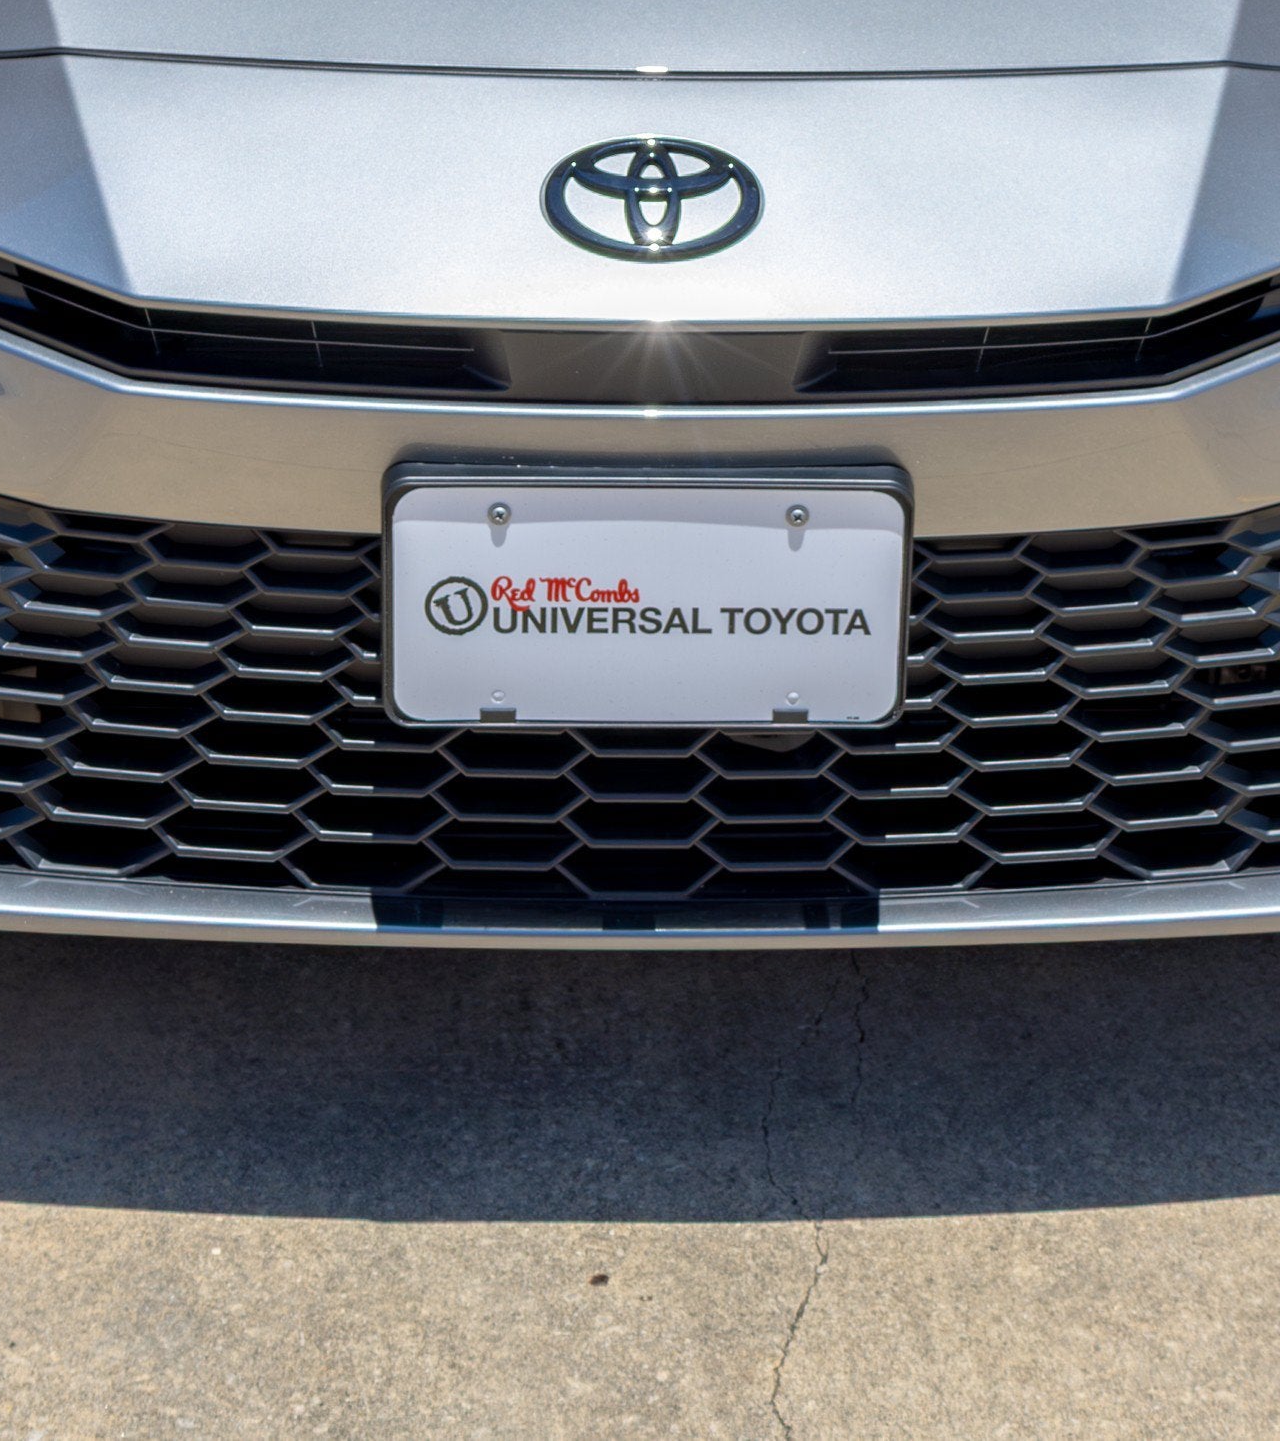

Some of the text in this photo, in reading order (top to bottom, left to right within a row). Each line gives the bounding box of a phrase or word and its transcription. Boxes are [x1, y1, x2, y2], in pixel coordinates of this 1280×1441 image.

[491, 575, 640, 612] Red McCombs
[492, 606, 872, 635] UNIVERSAL TOYOTA
